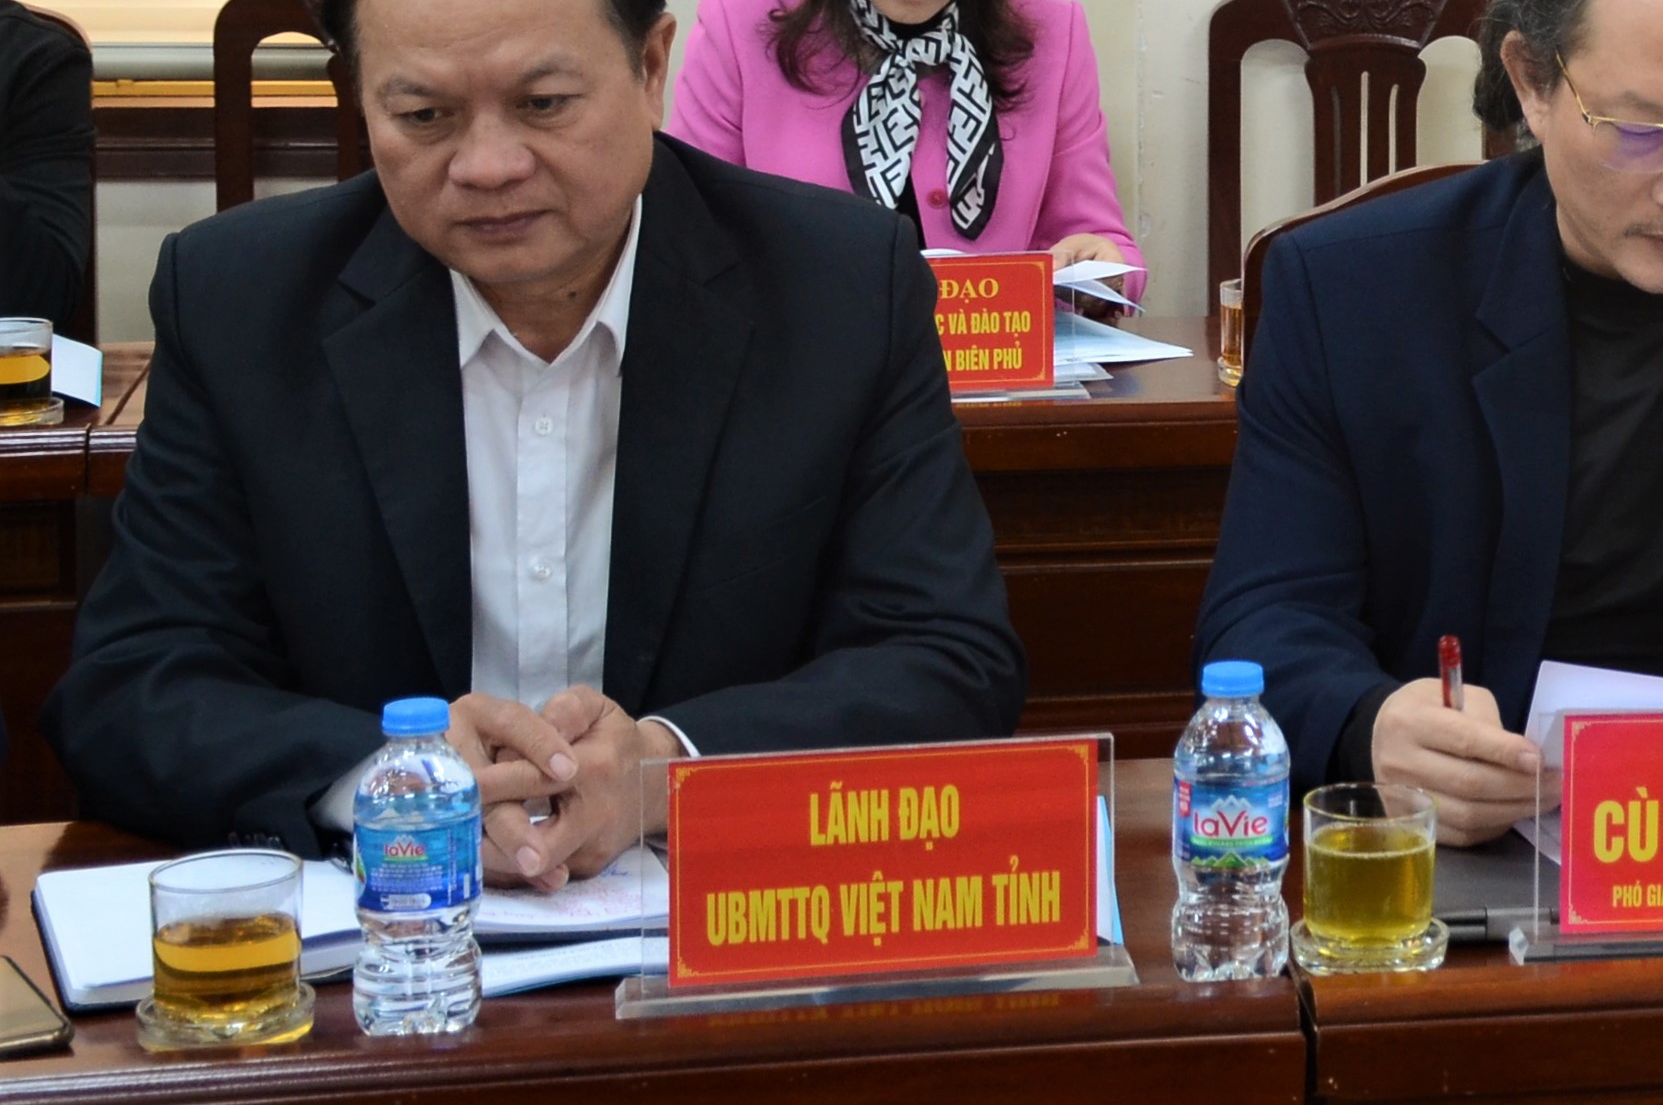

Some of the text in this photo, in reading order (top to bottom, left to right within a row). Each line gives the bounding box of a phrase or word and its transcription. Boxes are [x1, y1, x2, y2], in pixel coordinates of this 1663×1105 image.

[940, 278, 999, 304] ĐẠO
[948, 309, 967, 335] VÀ
[970, 307, 1000, 335] ĐÀO
[1003, 310, 1031, 338] TẠO
[955, 345, 990, 372] BIÊN
[993, 340, 1023, 370] PHỦ
[810, 781, 960, 850] LÃNH ĐẠO
[1593, 786, 1660, 863] CÙ
[707, 855, 1061, 947] UBMTTQ VIỆT NAM TỈNH
[1612, 881, 1644, 909] PHÓ
